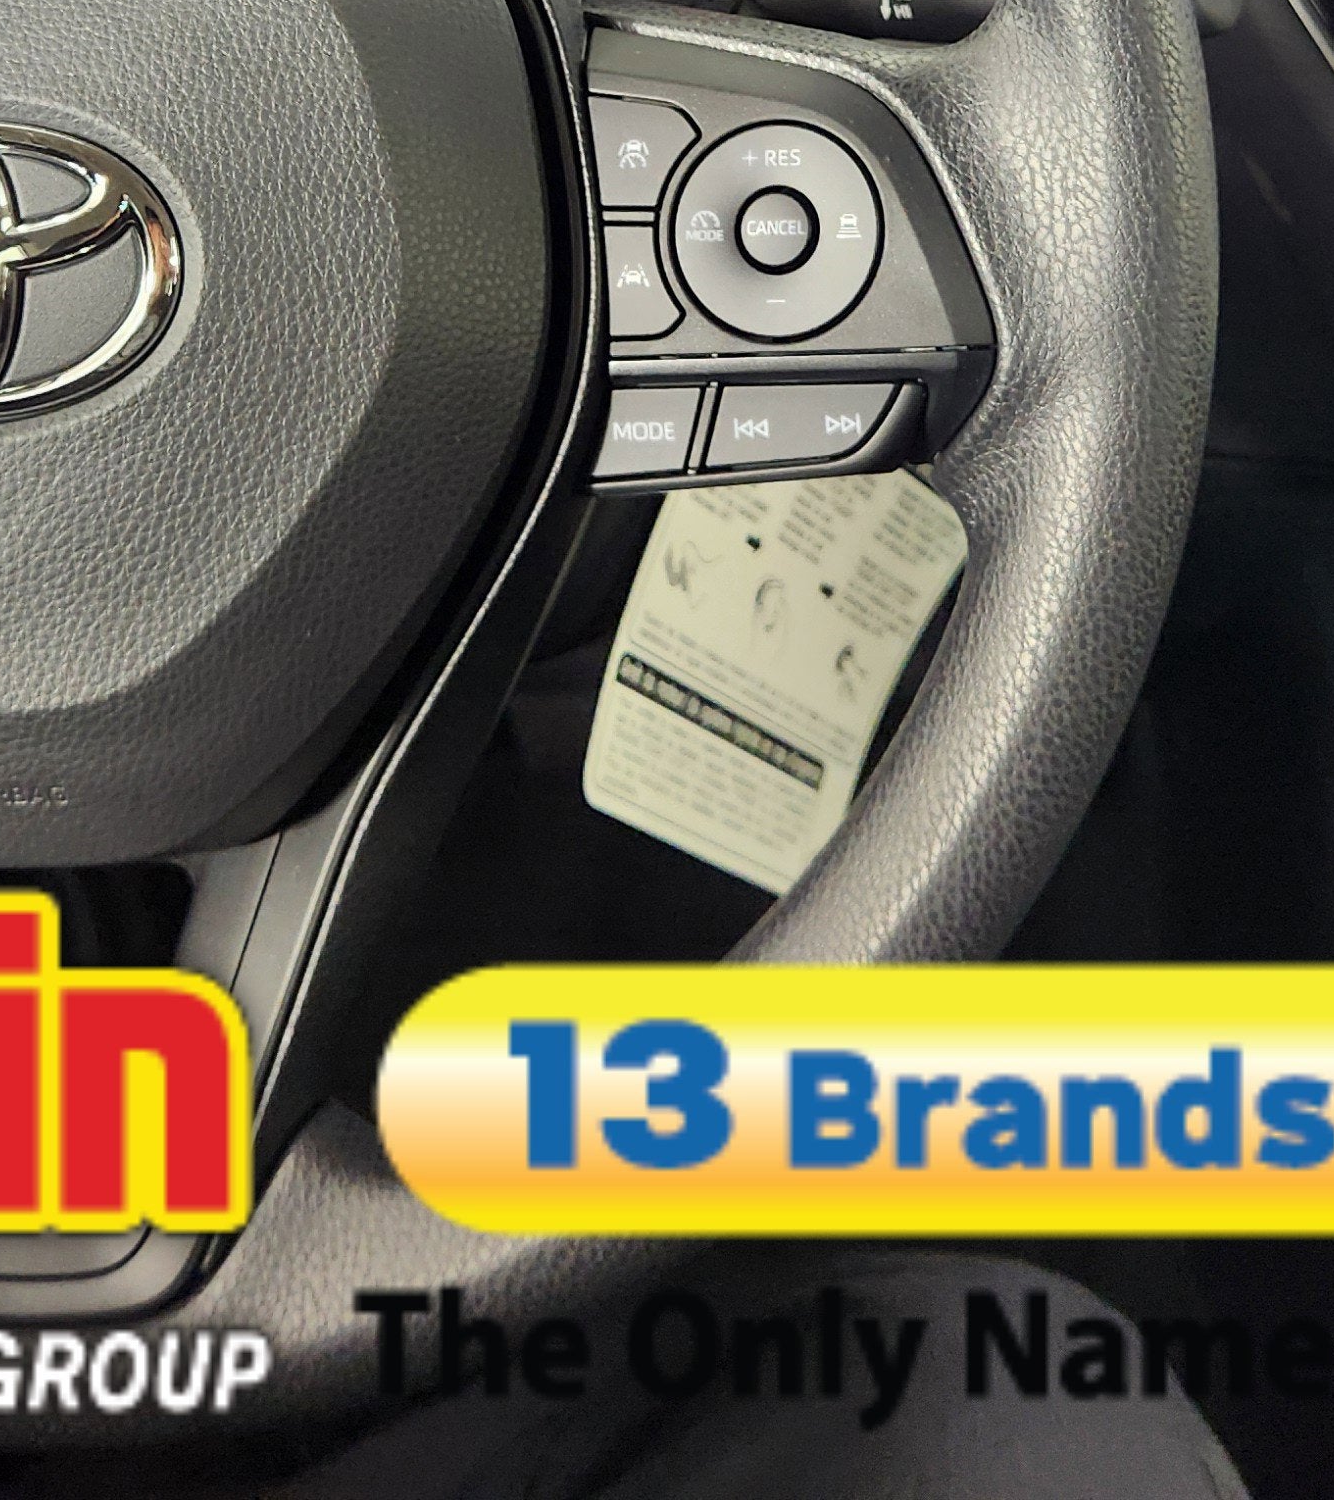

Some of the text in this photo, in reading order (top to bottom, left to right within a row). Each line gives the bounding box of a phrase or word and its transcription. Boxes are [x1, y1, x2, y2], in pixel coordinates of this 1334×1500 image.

[685, 229, 725, 243] MODE
[746, 218, 807, 236] CANCEL
[612, 421, 675, 441] MODE
